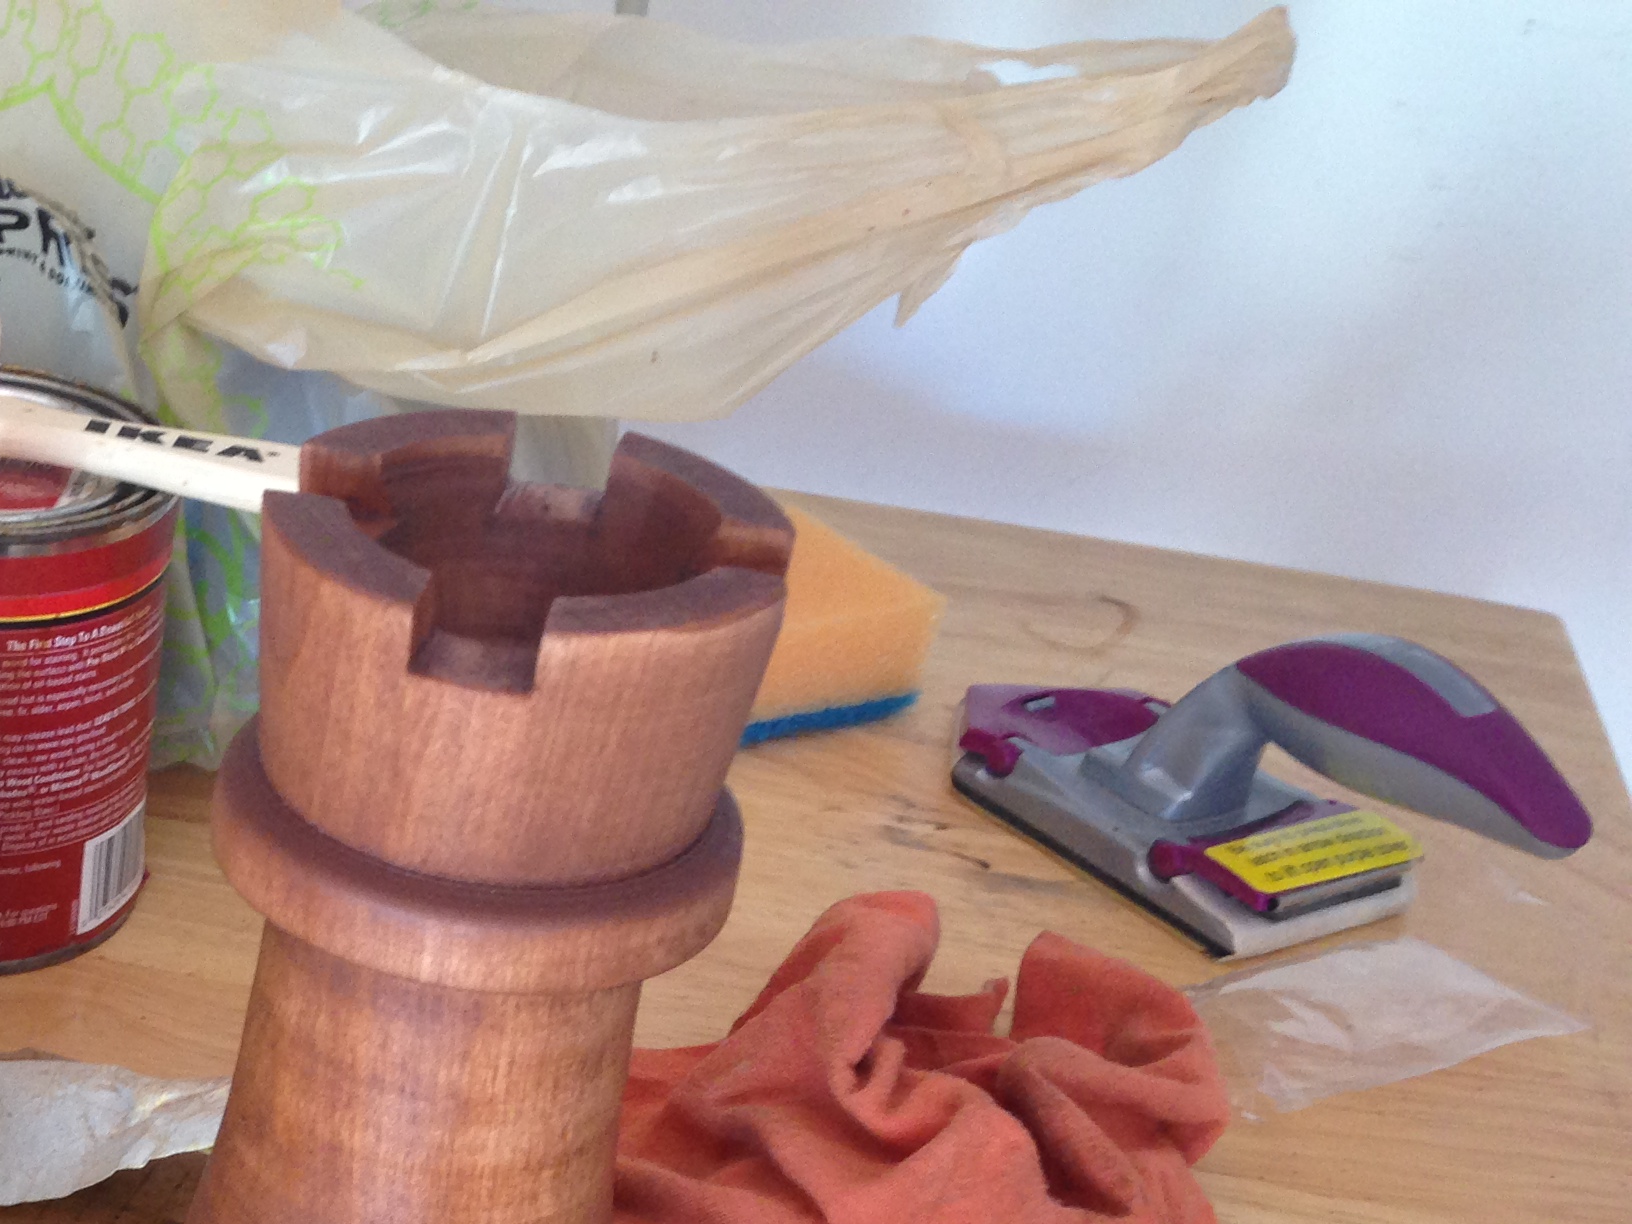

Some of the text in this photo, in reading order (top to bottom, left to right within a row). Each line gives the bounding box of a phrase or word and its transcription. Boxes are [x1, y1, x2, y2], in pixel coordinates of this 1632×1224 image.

[84, 418, 264, 463] IKEA
[6, 639, 28, 652] The
[28, 637, 53, 650] First
[52, 634, 78, 648] Step
[33, 767, 81, 786] Conditioner
